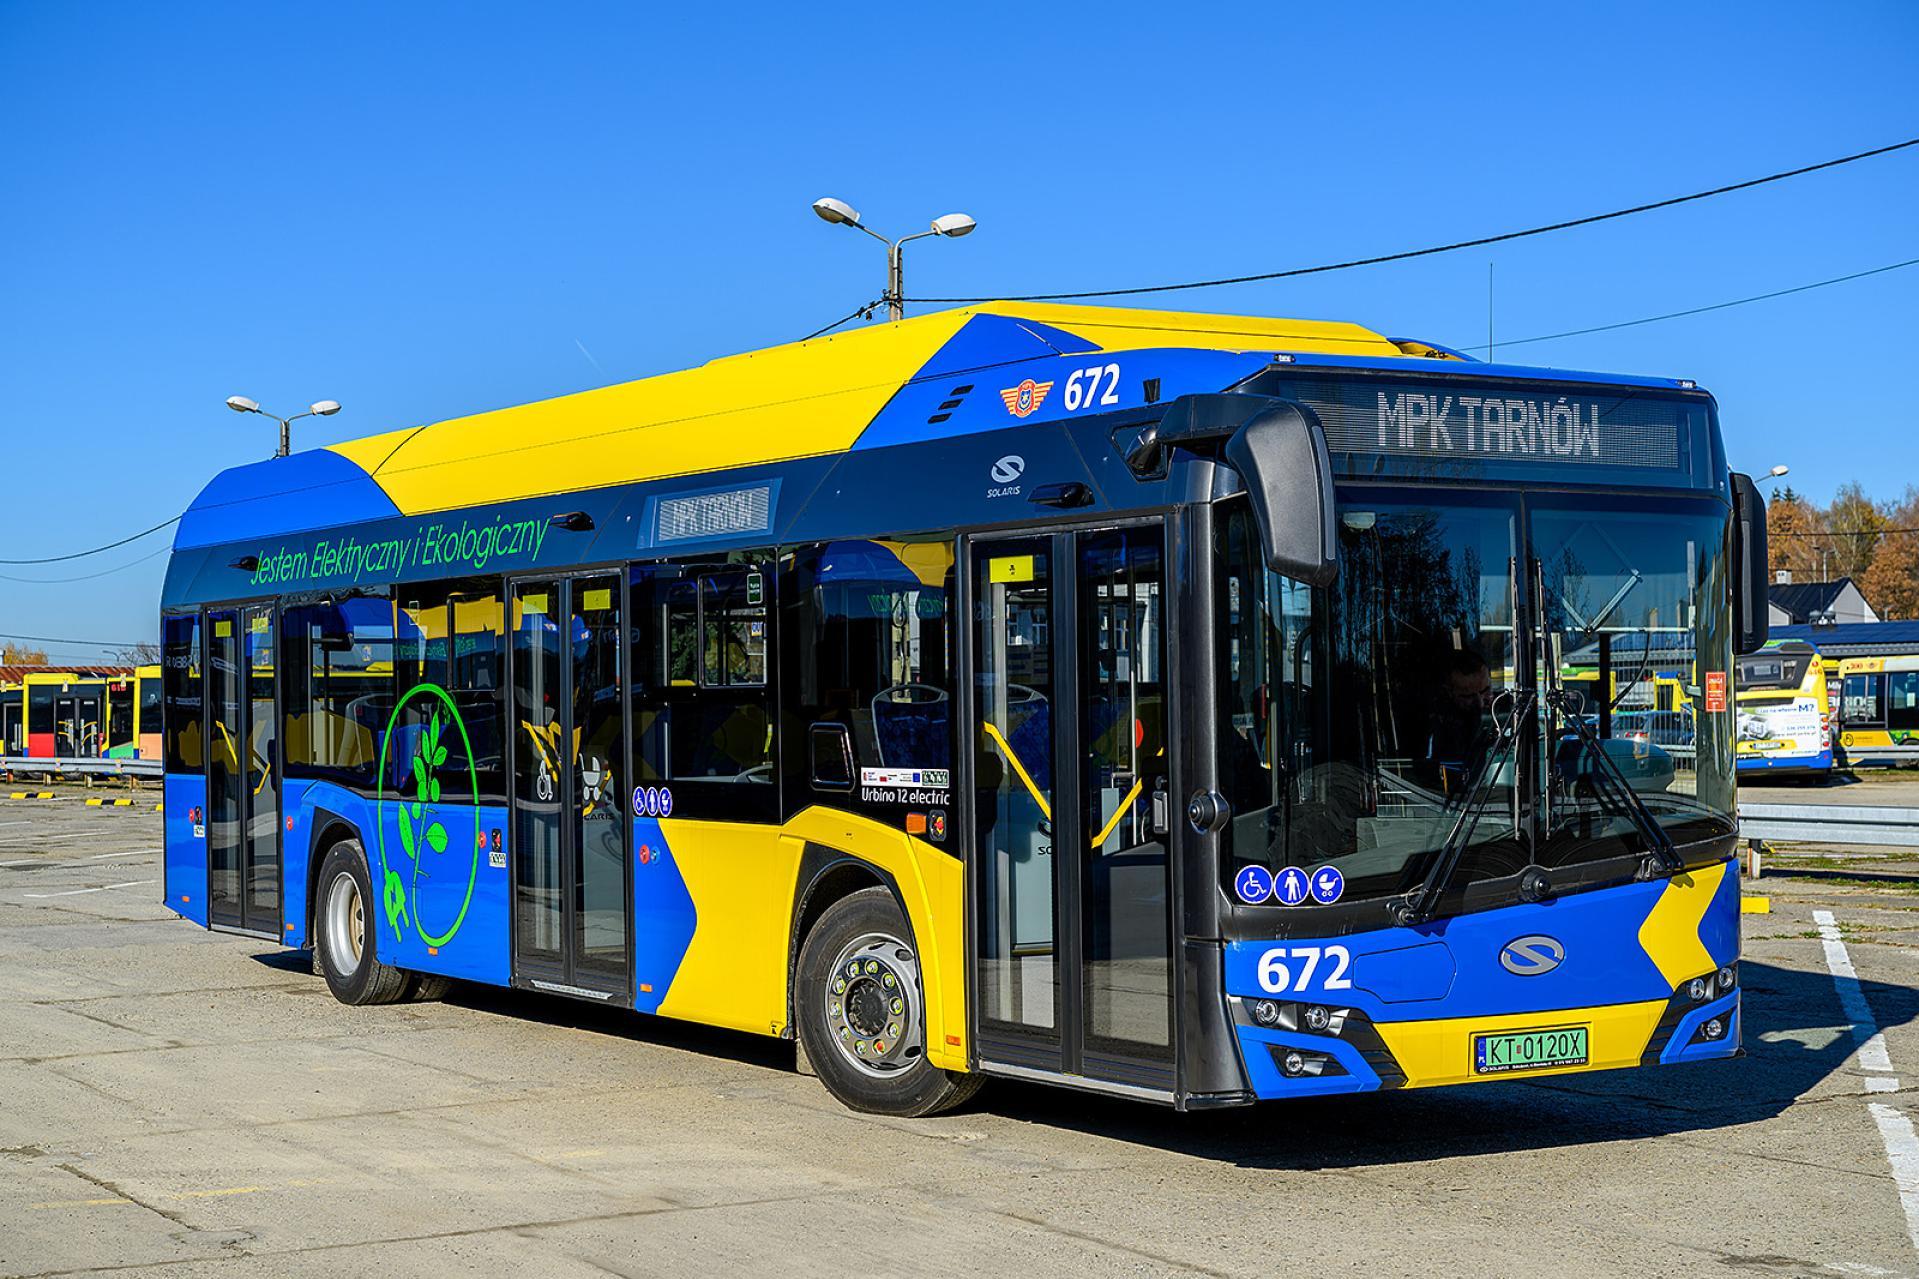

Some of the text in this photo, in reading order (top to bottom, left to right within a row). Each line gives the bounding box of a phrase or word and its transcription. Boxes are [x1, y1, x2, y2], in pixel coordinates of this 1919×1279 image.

[1064, 363, 1120, 411] 672
[1377, 391, 1599, 457] MPK TARNÓW
[986, 486, 1020, 498] SOLARIS
[250, 515, 551, 585] Jestem Elektryczny i Ekologiczny
[861, 787, 950, 805] Urbino 12 electric
[1257, 945, 1351, 993] 672
[1490, 1032, 1581, 1064] KT 0120X
